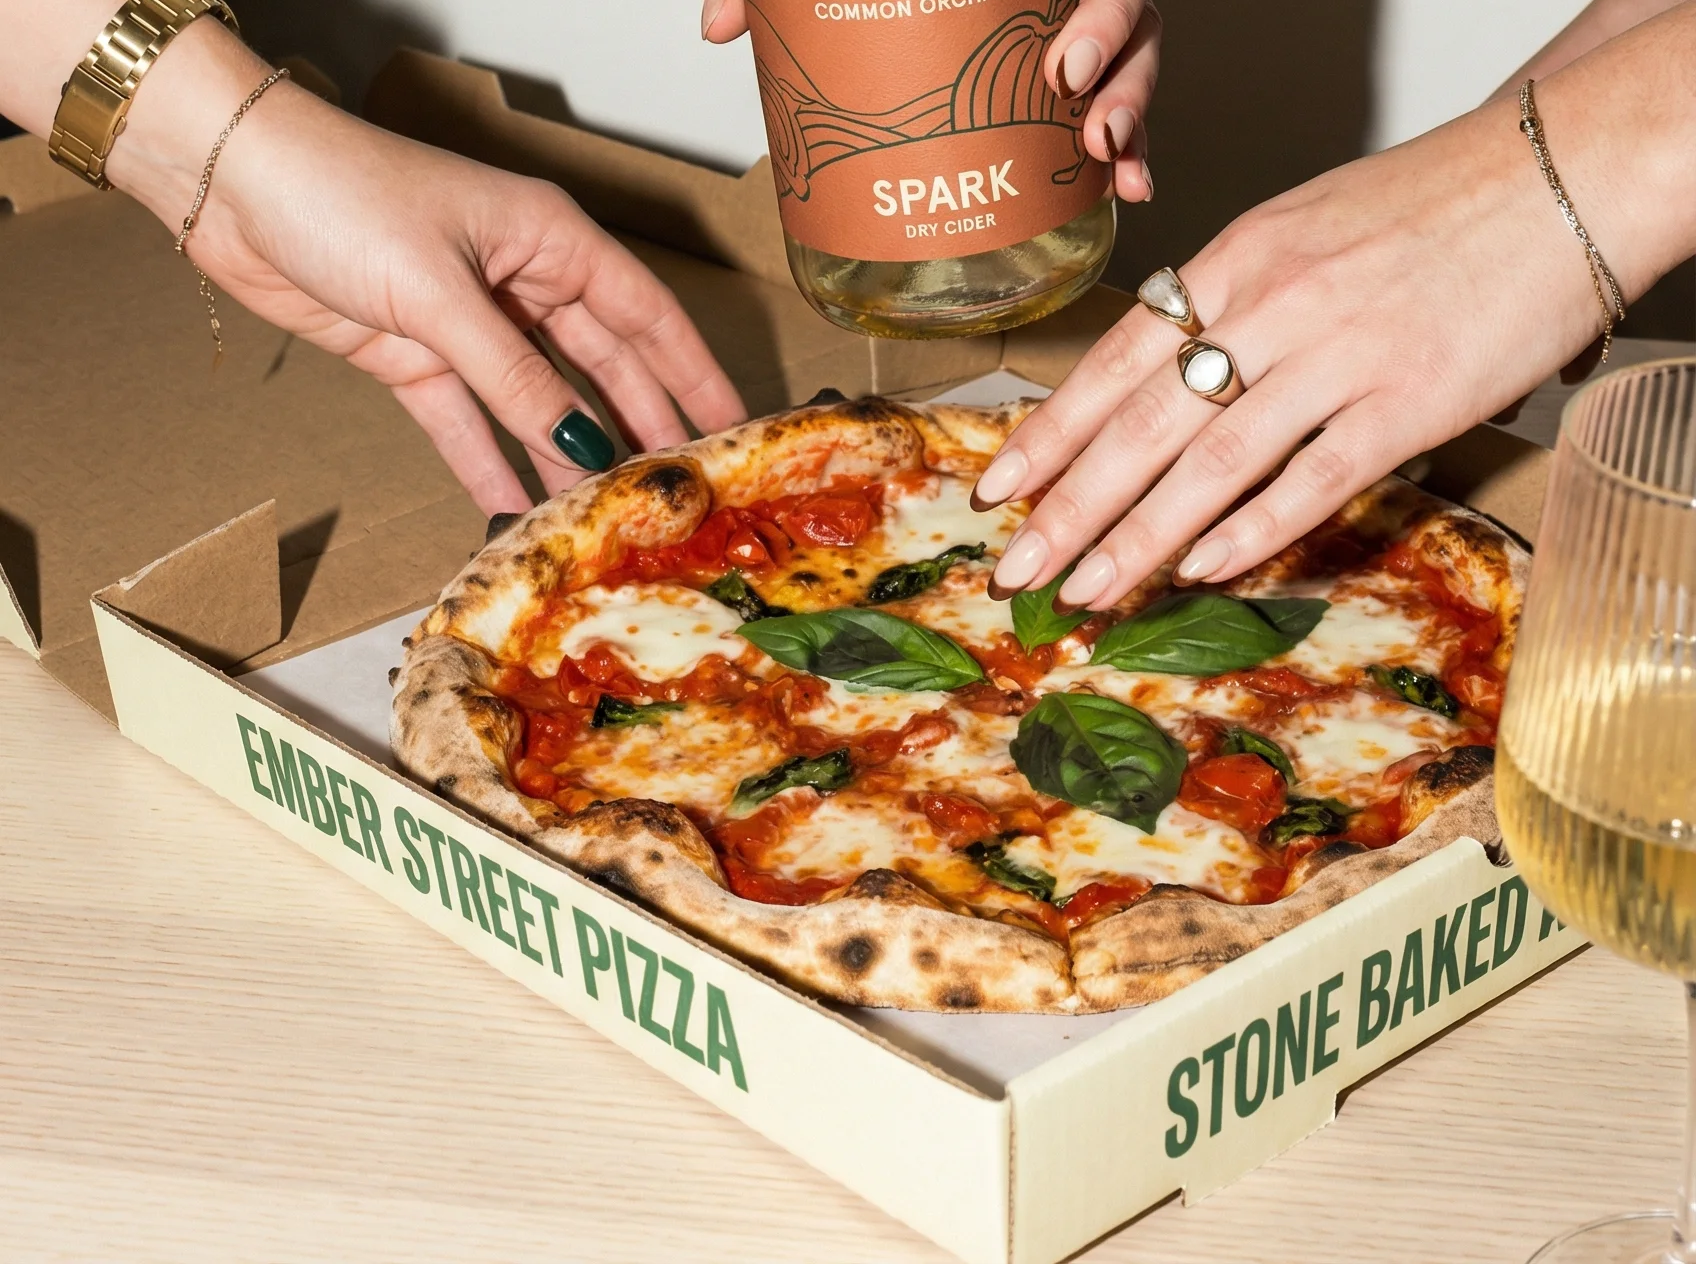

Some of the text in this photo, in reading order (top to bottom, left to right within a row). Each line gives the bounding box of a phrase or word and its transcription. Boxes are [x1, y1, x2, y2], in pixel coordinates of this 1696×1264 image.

[814, 0, 912, 21] COMMON
[873, 159, 1020, 216] SPARK
[905, 213, 997, 238] DRY CIDER
[236, 713, 749, 1093] EMBER STREET PIZZA
[1164, 874, 1529, 1159] STONE BAKED
